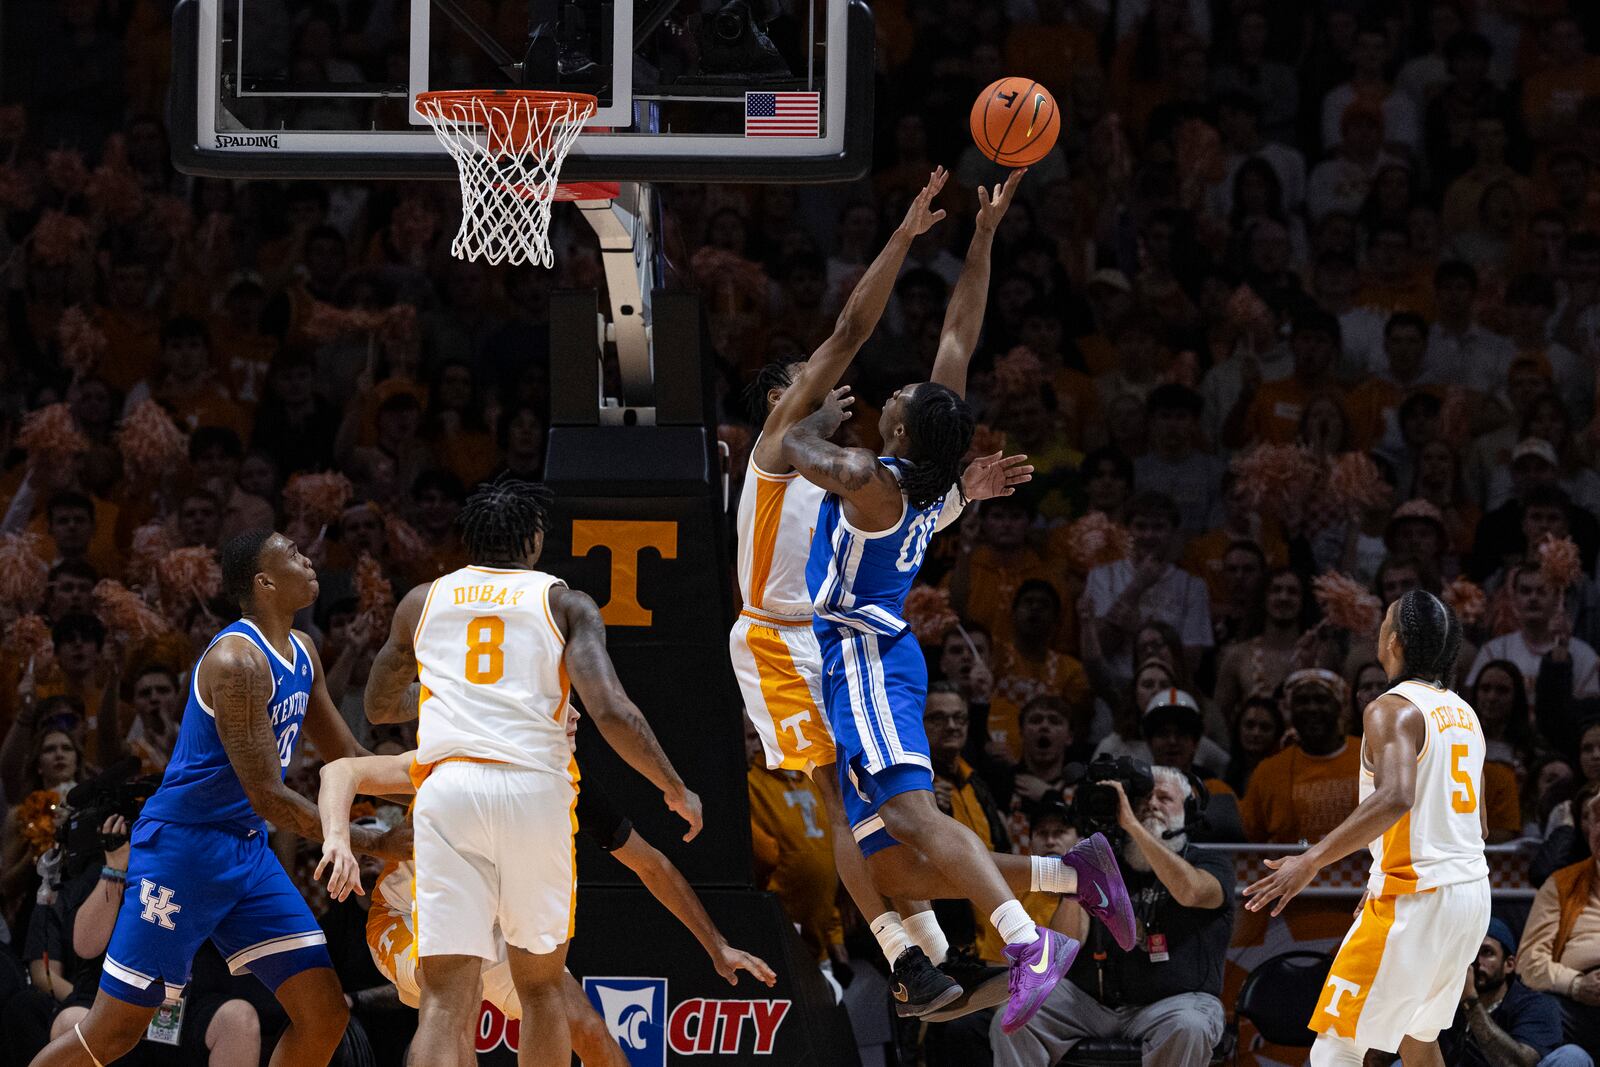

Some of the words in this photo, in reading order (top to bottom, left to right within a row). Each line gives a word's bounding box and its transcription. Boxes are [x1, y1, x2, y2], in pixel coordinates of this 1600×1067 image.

[215, 134, 279, 149] SPALDING
[453, 584, 525, 606] DUBAR
[572, 519, 678, 627] T
[465, 615, 506, 685] 8
[780, 709, 814, 753] T
[1450, 743, 1477, 814] 5
[1323, 973, 1361, 1018] T
[667, 996, 793, 1056] CITY
